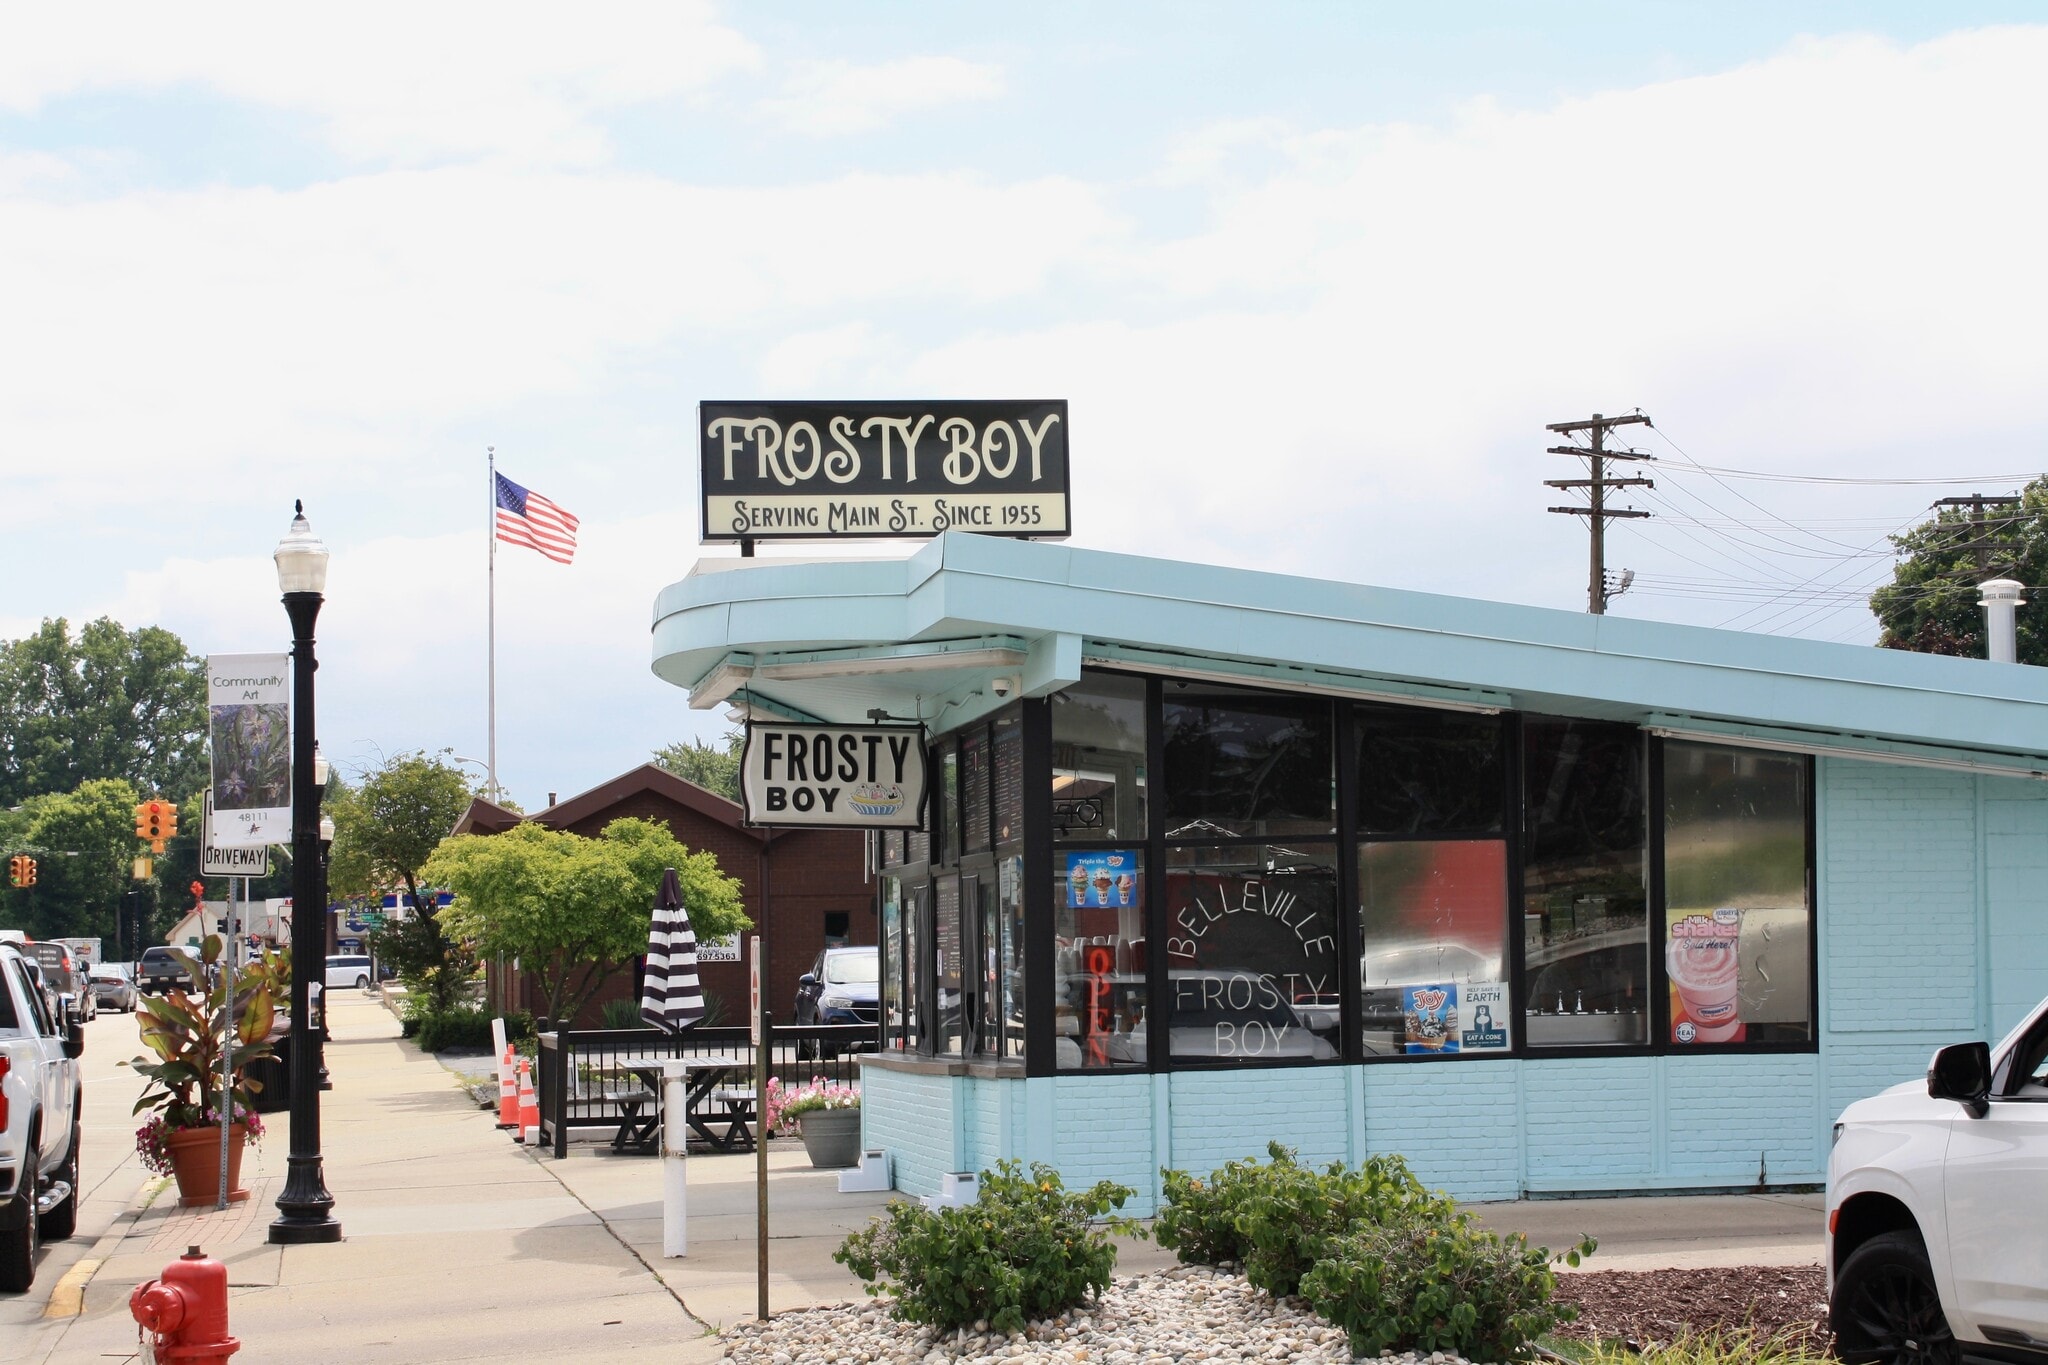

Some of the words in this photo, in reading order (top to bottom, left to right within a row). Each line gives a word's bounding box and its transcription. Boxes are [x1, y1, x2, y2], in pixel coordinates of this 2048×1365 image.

[707, 413, 935, 487] FROSTY
[938, 413, 1060, 486] BOY
[1001, 505, 1042, 526] 1955
[212, 675, 284, 688] Community
[242, 689, 259, 700] Art
[763, 732, 911, 784] FROSTY
[766, 786, 841, 813] BOY
[238, 811, 268, 822] 48111
[205, 848, 264, 866] DRIVEWAY
[1166, 880, 1336, 959] BELLEVILLE
[1176, 973, 1328, 1011] FROSTY
[1466, 992, 1501, 1002] EARTH
[1215, 1020, 1289, 1056] BOY
